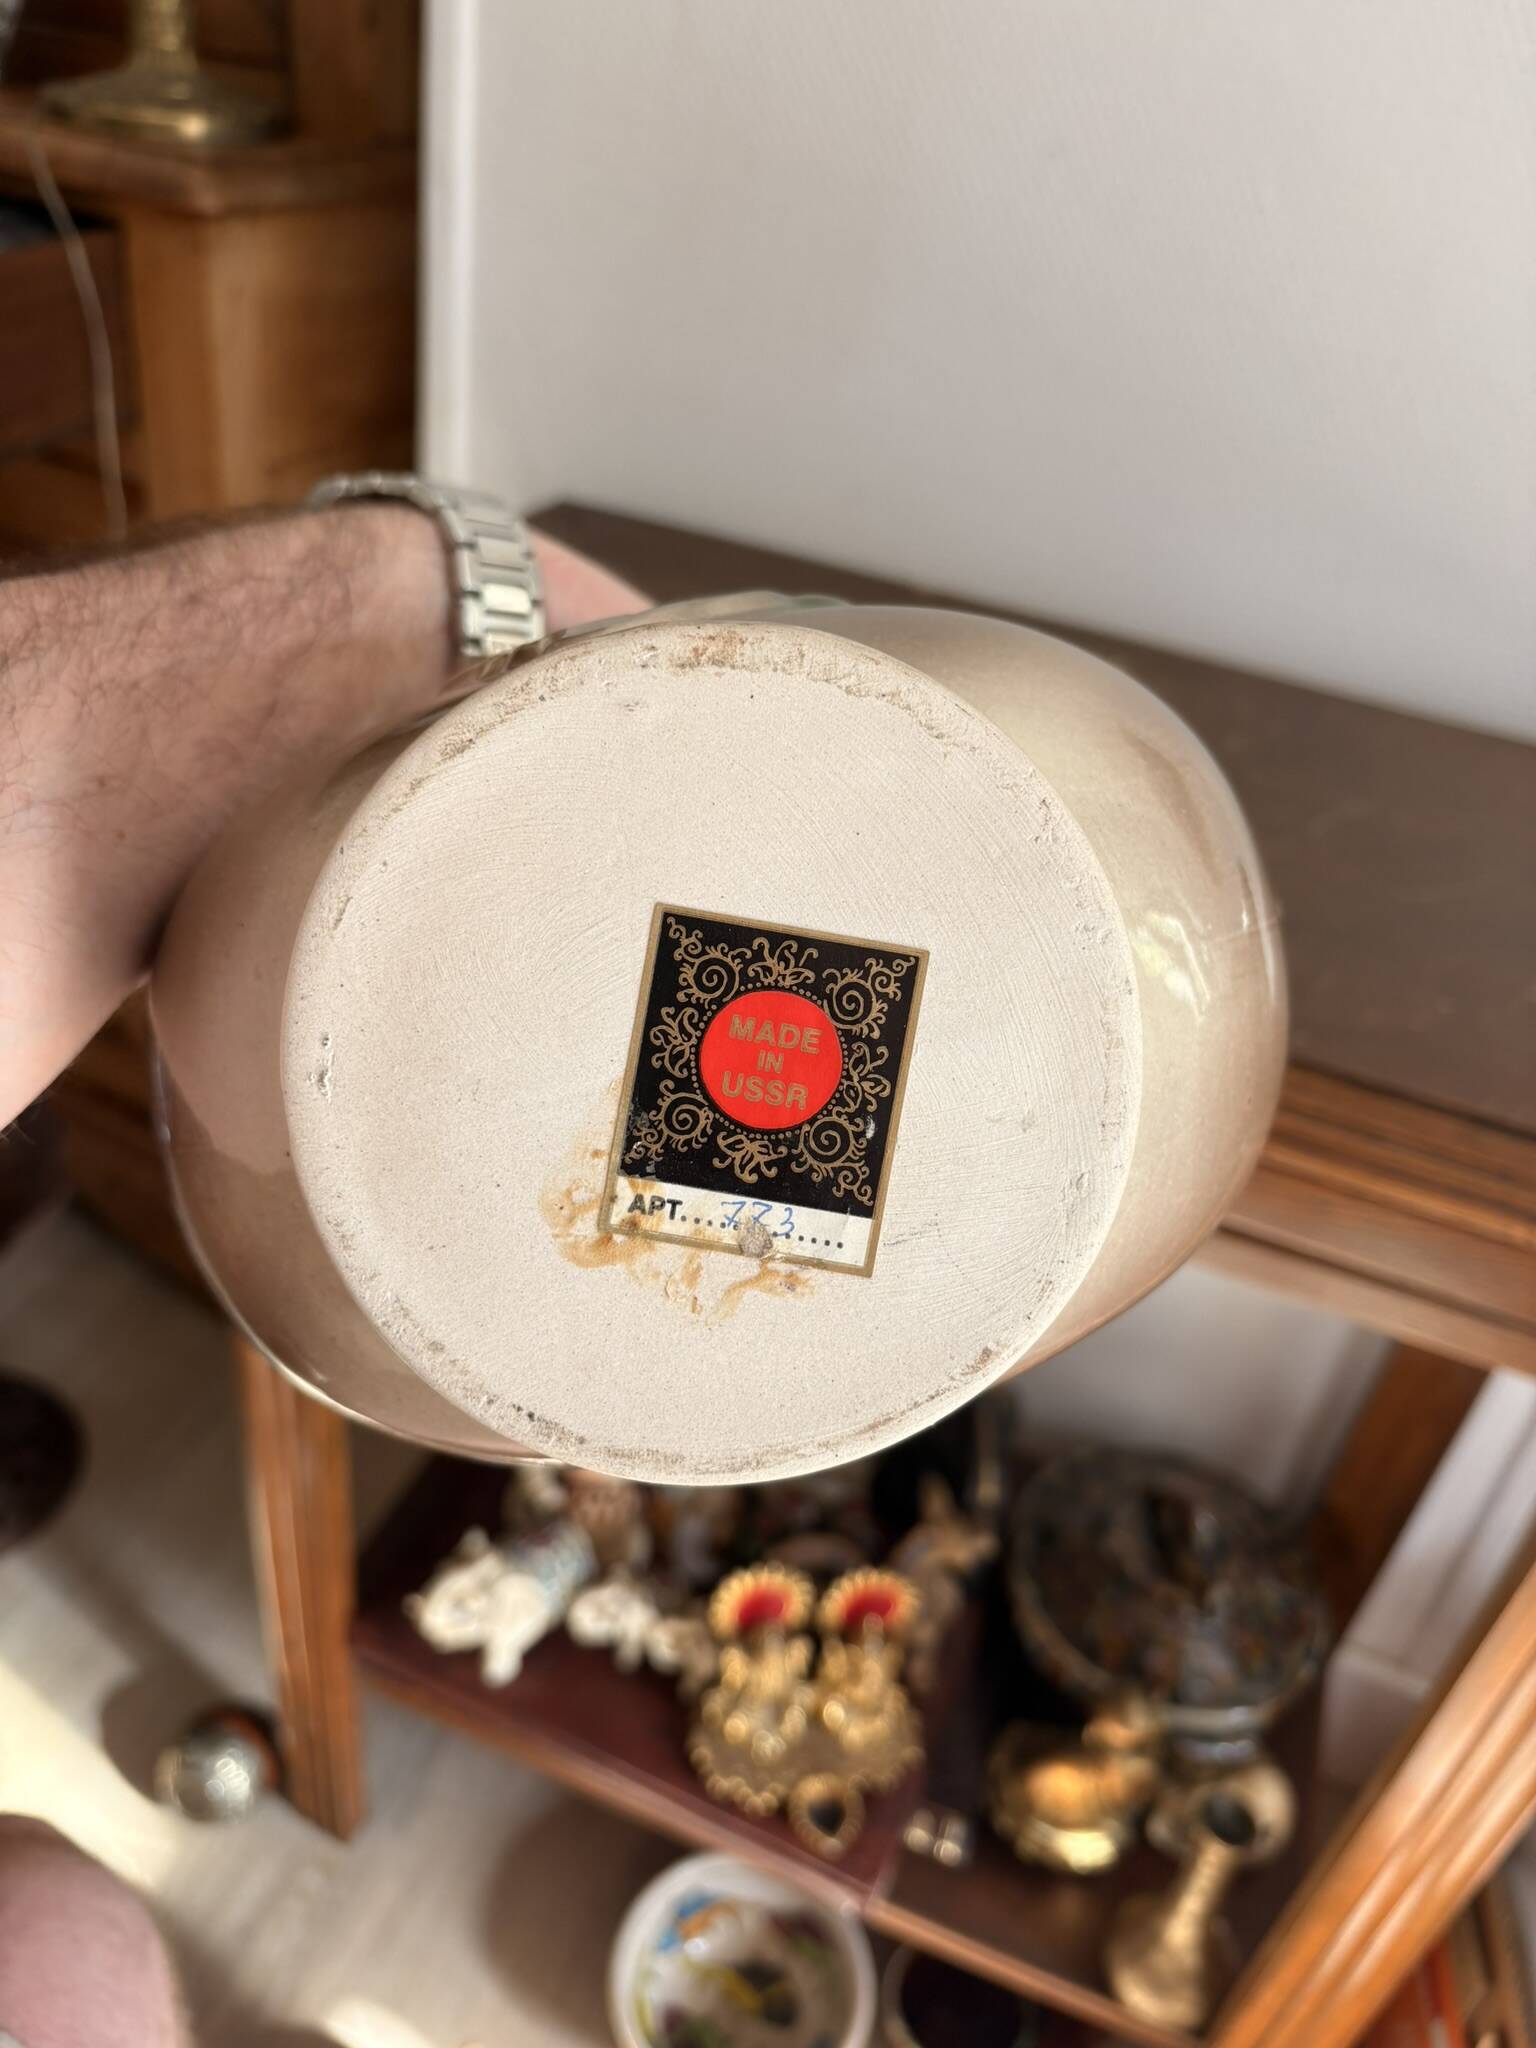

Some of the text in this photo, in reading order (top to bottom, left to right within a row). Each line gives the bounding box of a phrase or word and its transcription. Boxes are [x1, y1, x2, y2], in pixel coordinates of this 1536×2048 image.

[728, 1014, 823, 1055] MADE
[757, 1049, 784, 1074] IN
[721, 1071, 809, 1111] USSR
